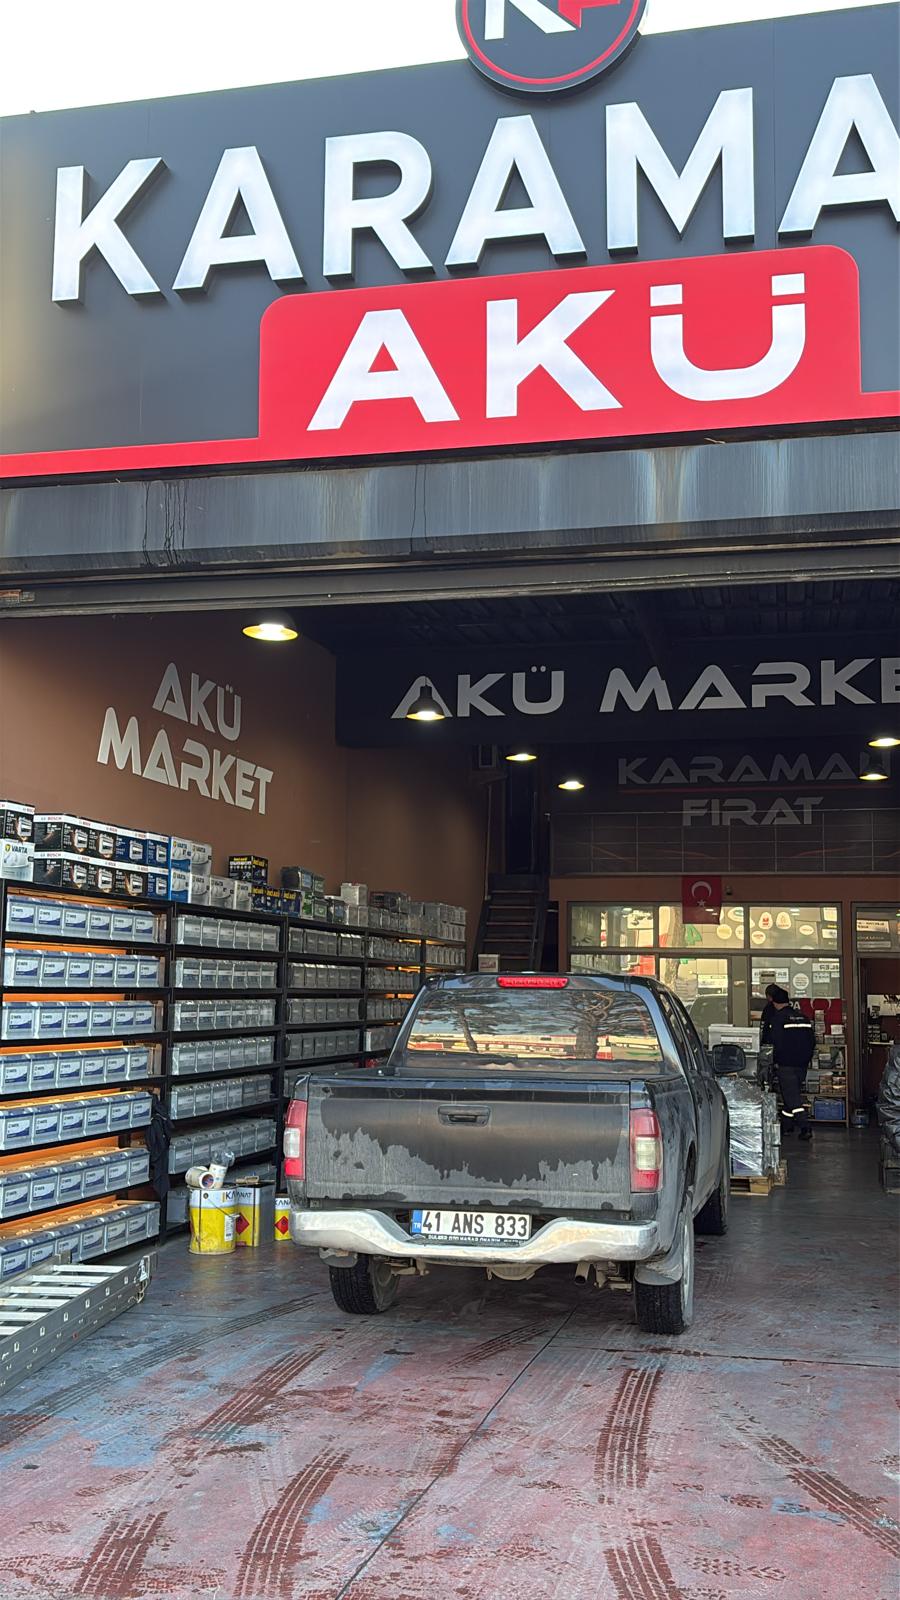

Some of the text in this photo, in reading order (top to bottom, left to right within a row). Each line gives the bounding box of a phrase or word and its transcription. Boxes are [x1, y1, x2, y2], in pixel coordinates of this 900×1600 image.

[51, 73, 900, 303] KARAMA
[306, 273, 806, 431] AKÜ
[152, 662, 242, 741] AKÜ
[392, 666, 565, 719] AKÜ
[97, 706, 274, 815] MARKET
[682, 796, 824, 827] FIRAT
[11, 845, 28, 854] VARTA
[423, 1211, 441, 1233] 41
[451, 1213, 484, 1235] ANS
[495, 1215, 528, 1237] 833
